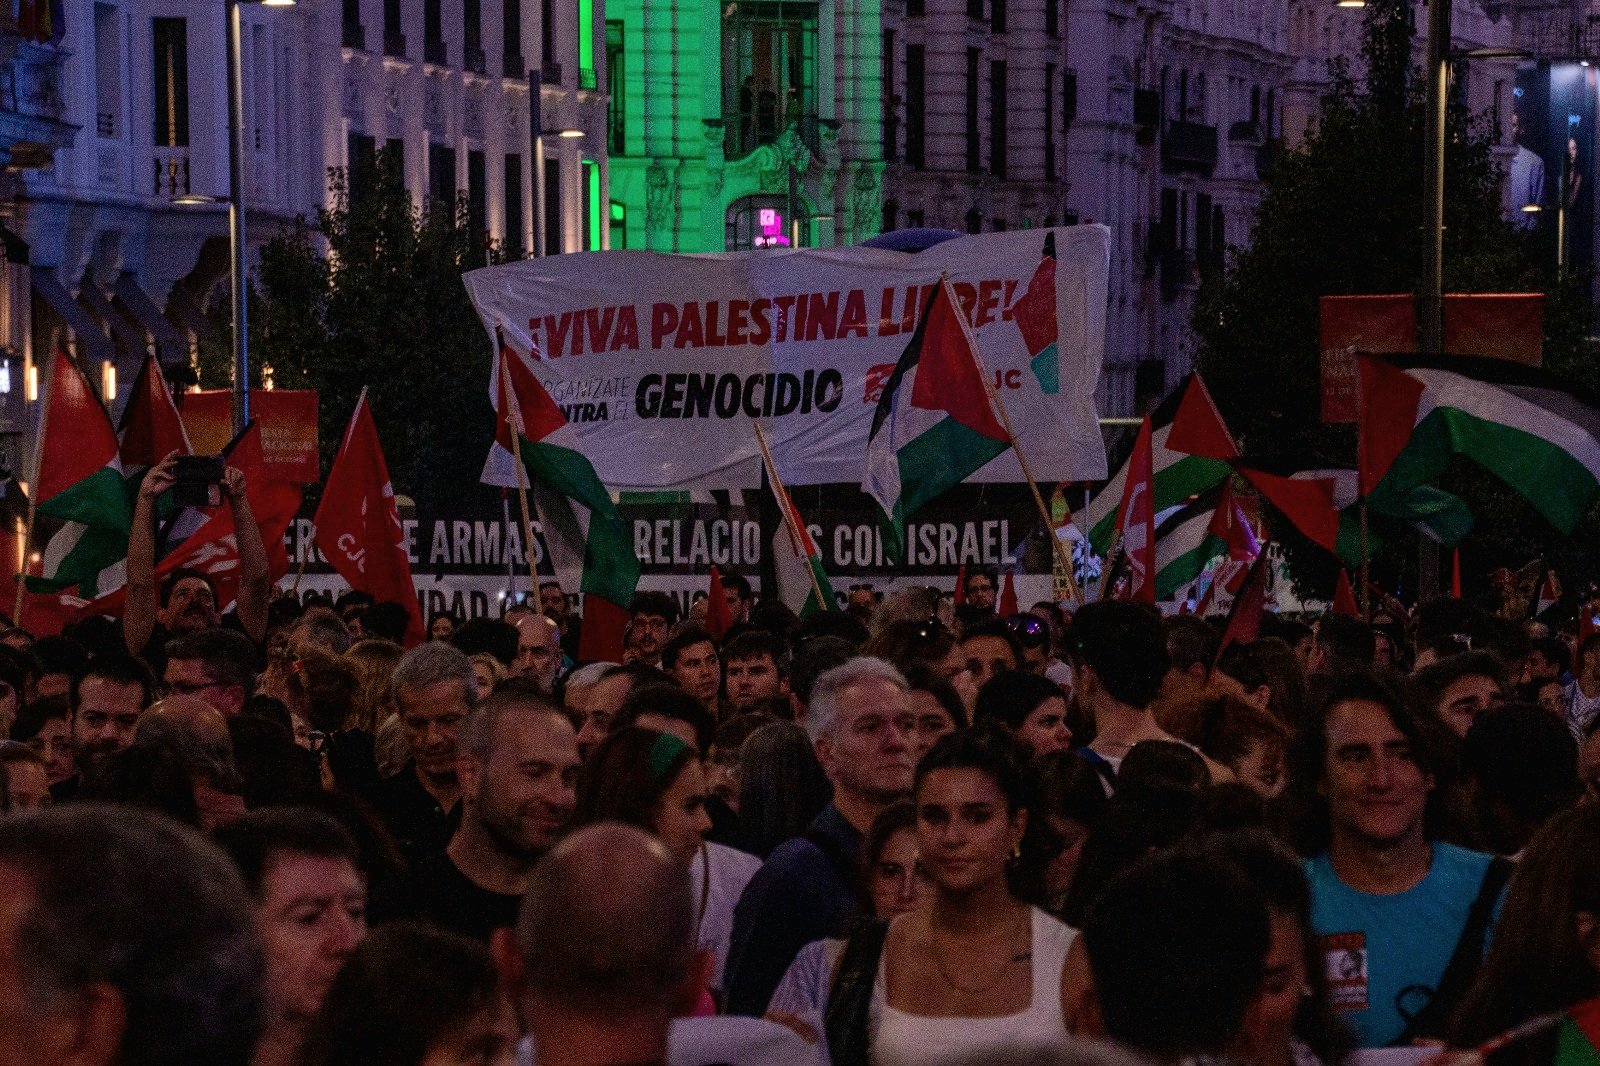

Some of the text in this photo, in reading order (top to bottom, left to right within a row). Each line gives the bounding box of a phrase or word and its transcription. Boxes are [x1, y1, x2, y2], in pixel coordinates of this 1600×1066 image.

[529, 304, 639, 361] ¡VIVA
[652, 289, 868, 349] PALESTINA
[635, 368, 844, 420] GENOCIDIO
[429, 519, 544, 565] ARMAS
[907, 519, 1018, 566] ISRAEL
